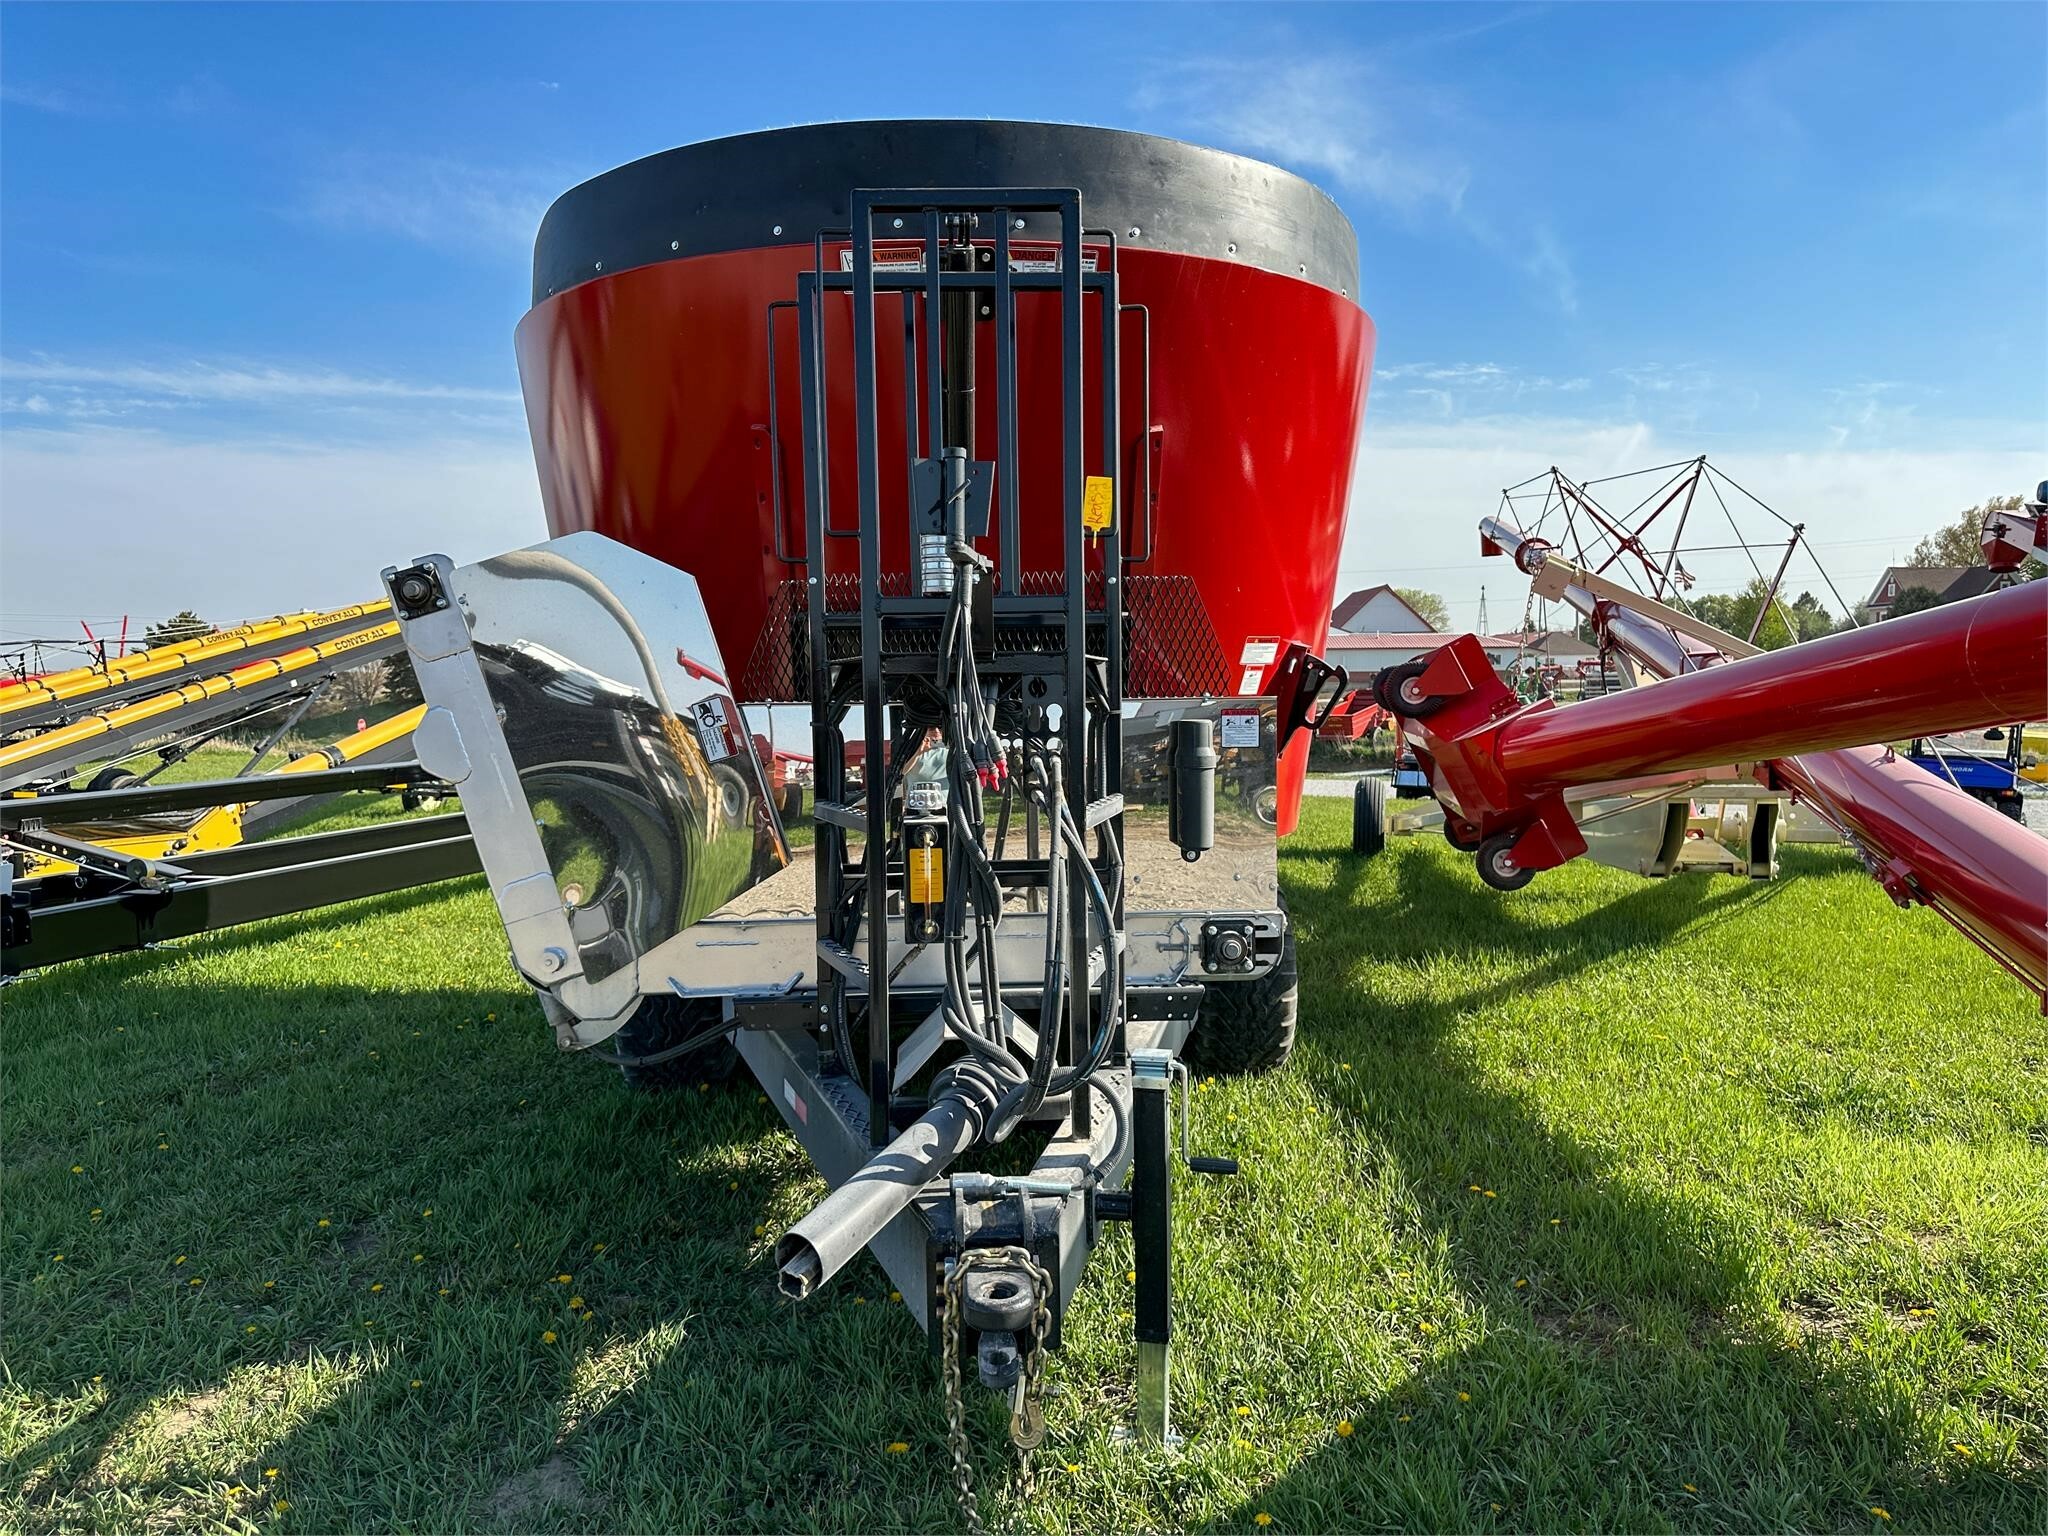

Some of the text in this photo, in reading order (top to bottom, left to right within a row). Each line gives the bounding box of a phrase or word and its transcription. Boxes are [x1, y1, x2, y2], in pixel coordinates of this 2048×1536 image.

[880, 251, 918, 261] WARNING
[1015, 251, 1054, 261] DANGER
[312, 608, 358, 626] CONVEY-ALL
[206, 628, 248, 643] CONVEY-ALL
[334, 628, 388, 651] CONVEY-ALL
